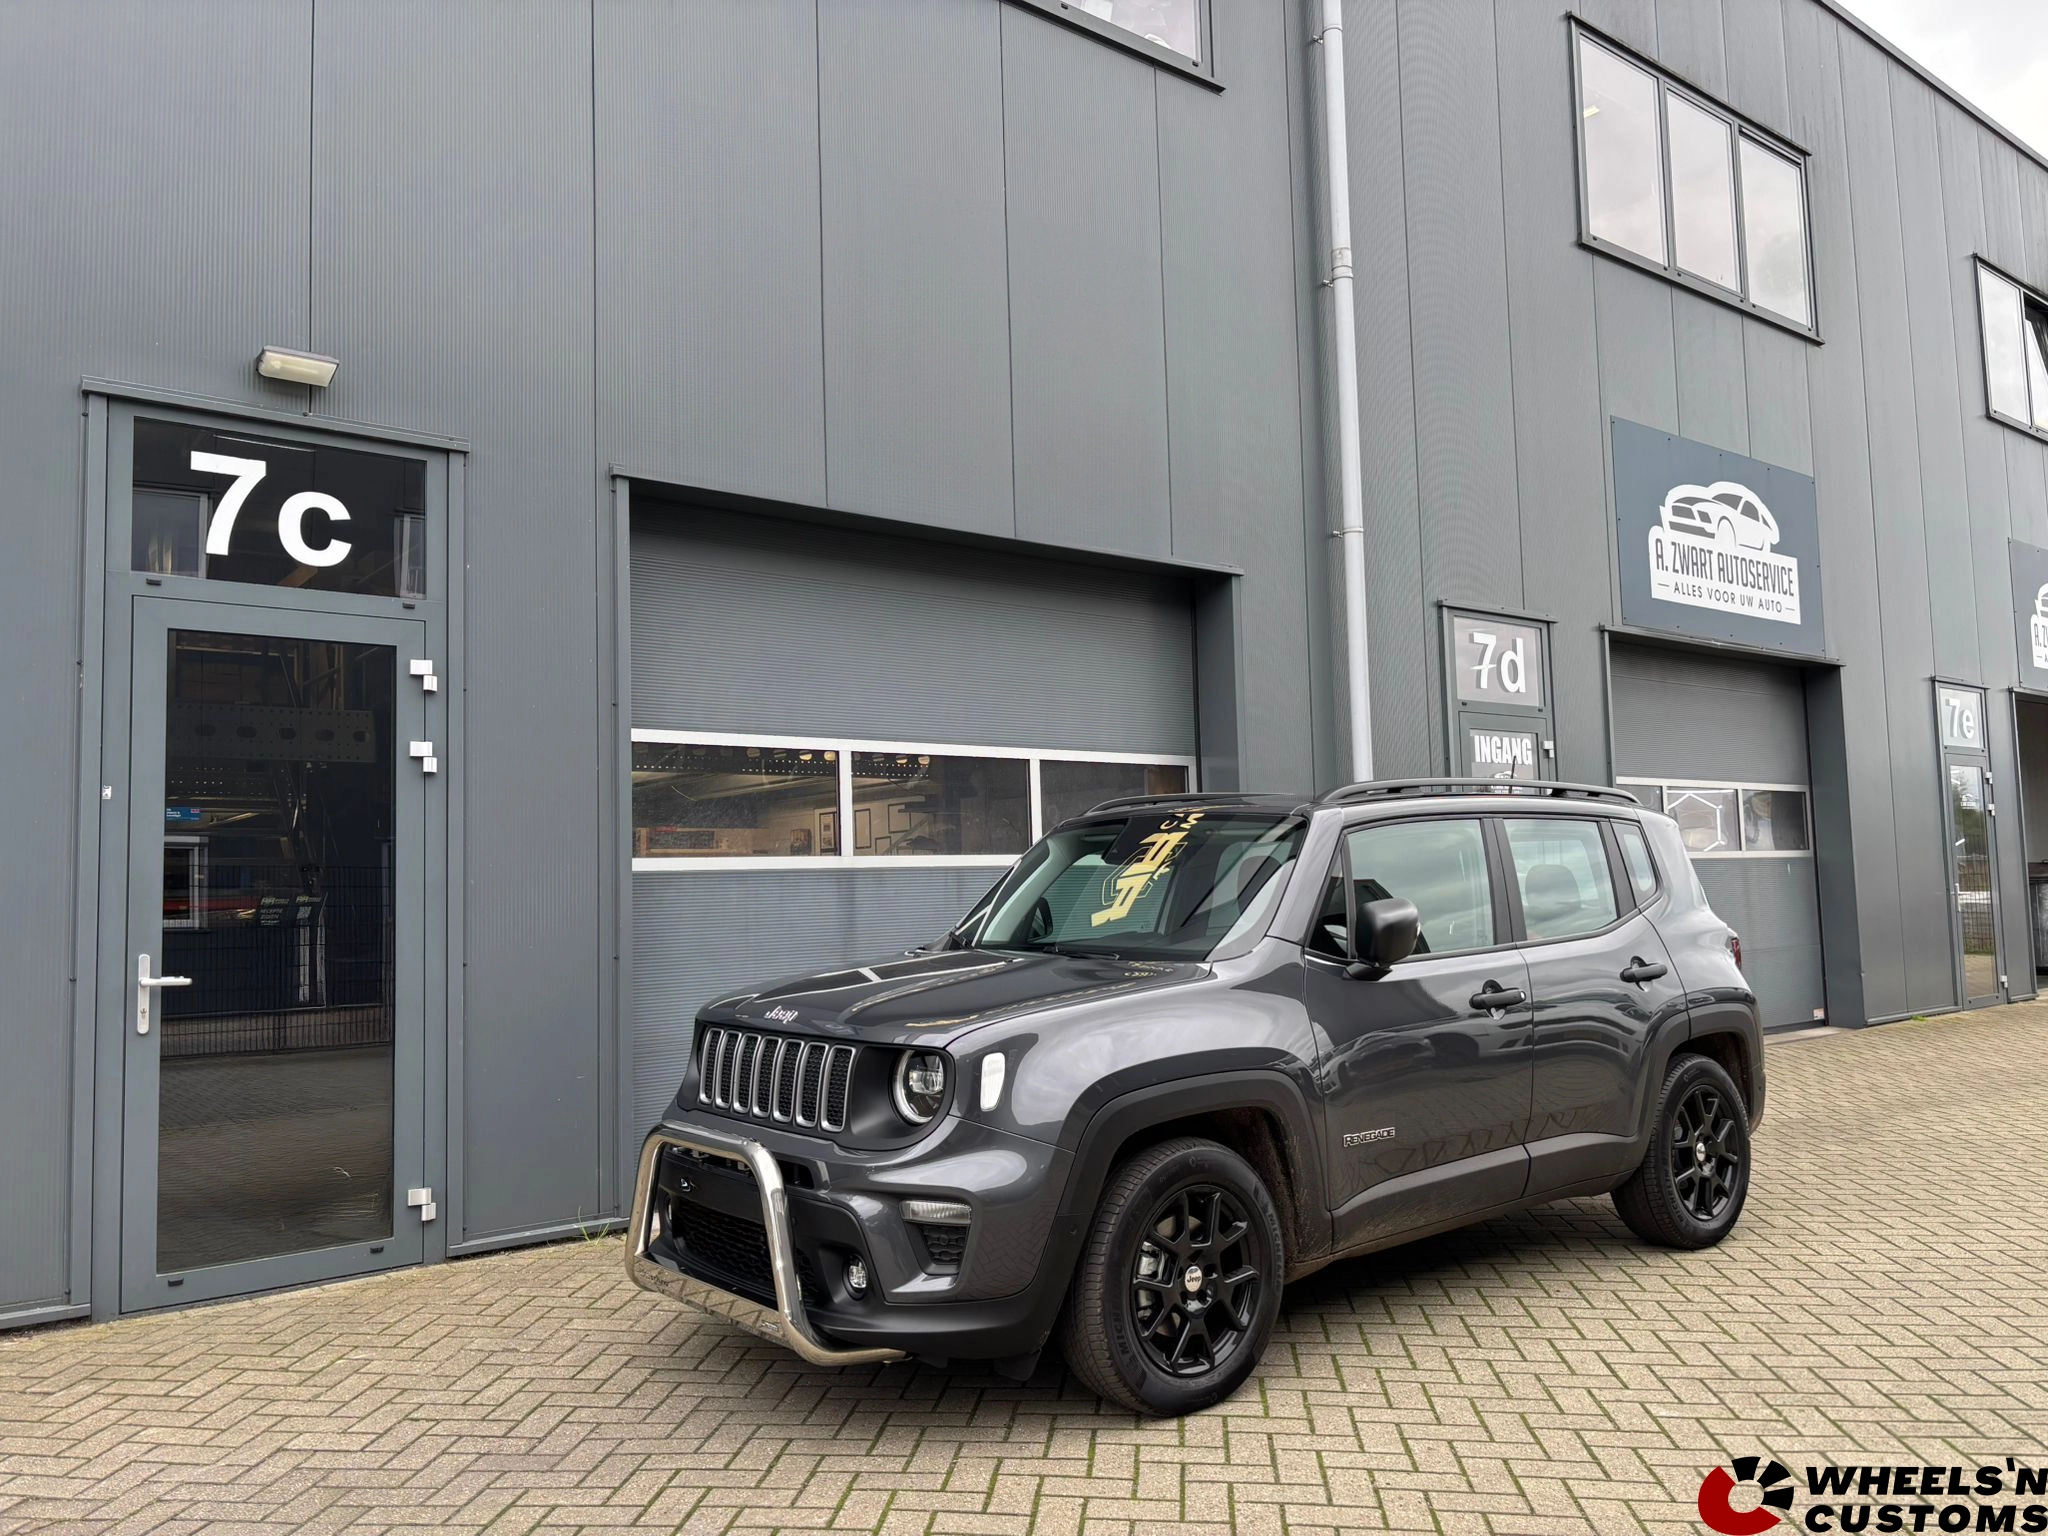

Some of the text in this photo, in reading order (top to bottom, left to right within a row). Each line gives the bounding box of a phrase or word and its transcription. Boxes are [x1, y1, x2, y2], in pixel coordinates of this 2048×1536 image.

[1655, 538, 1795, 597] A. ZWART AUTOSERVICE
[1673, 581, 1783, 613] ALLES VOOR UW AUTO
[1473, 631, 1527, 693] 7d
[1948, 698, 1975, 739] 7e
[1474, 735, 1533, 765] INGANG
[763, 1005, 799, 1025] Jeep
[1343, 1127, 1396, 1148] RENEGADE
